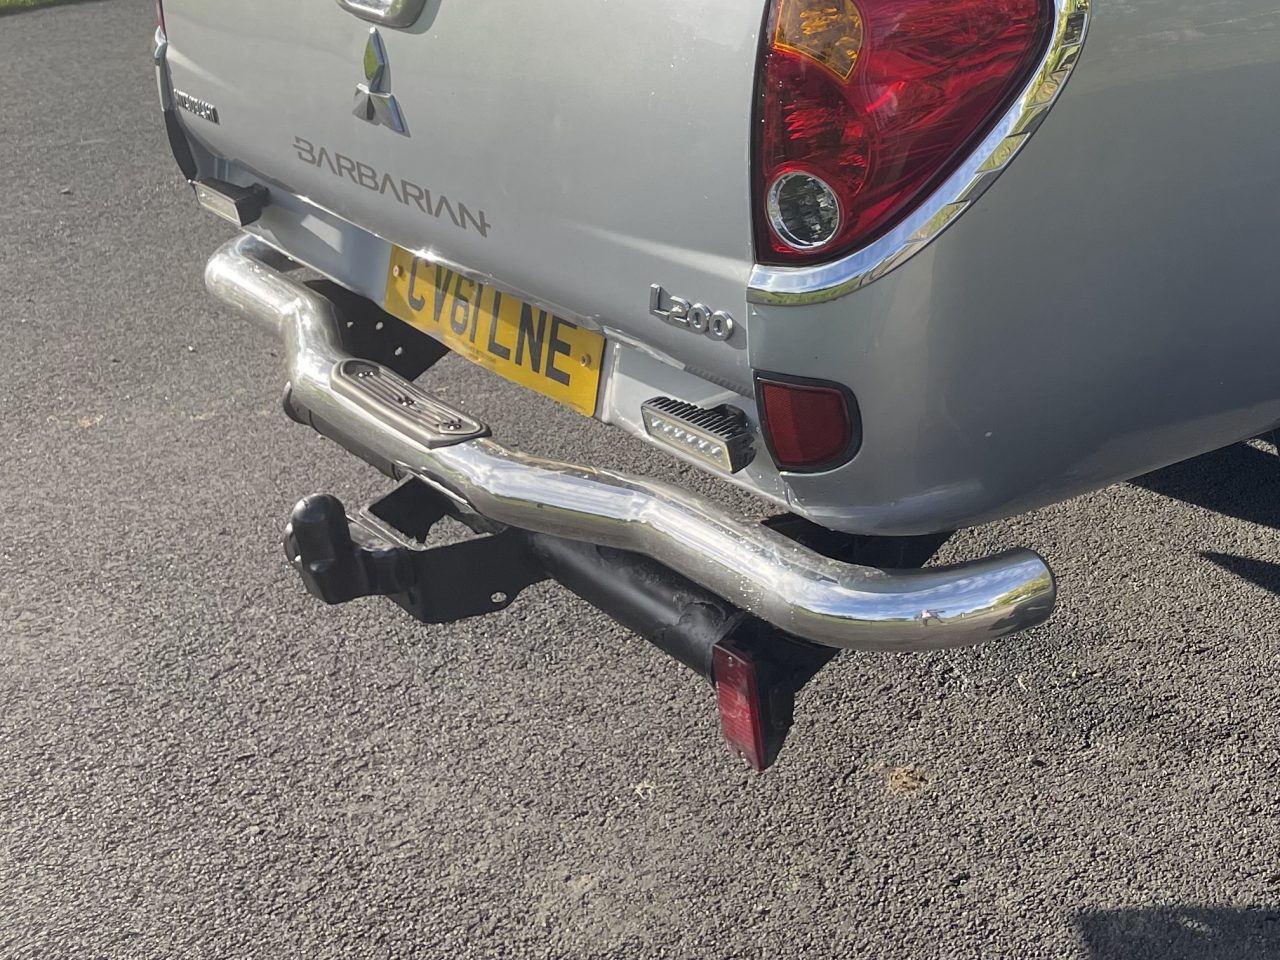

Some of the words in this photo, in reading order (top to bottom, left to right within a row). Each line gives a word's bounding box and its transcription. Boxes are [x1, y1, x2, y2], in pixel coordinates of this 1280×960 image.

[292, 135, 492, 238] BARBARIAN
[407, 255, 484, 344] CV61
[487, 289, 578, 387] LNE
[649, 283, 734, 342] L200
